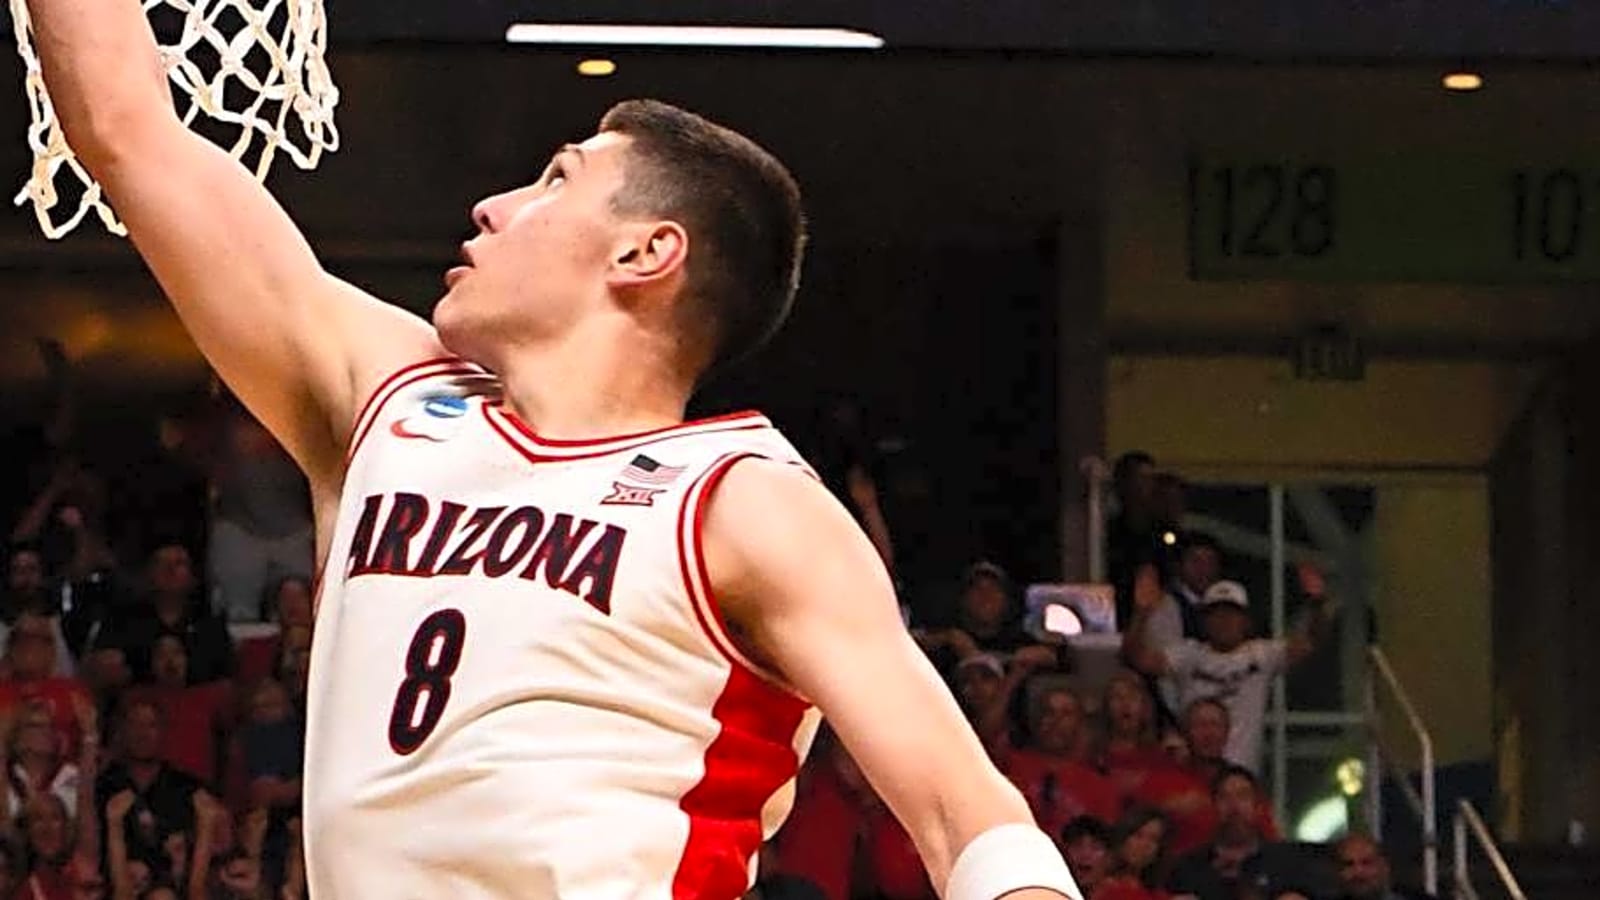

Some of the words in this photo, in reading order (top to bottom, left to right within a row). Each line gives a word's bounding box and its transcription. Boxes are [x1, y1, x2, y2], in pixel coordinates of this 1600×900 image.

[1213, 164, 1336, 256] 128
[348, 492, 627, 616] ARIZONA
[388, 608, 466, 755] 8
